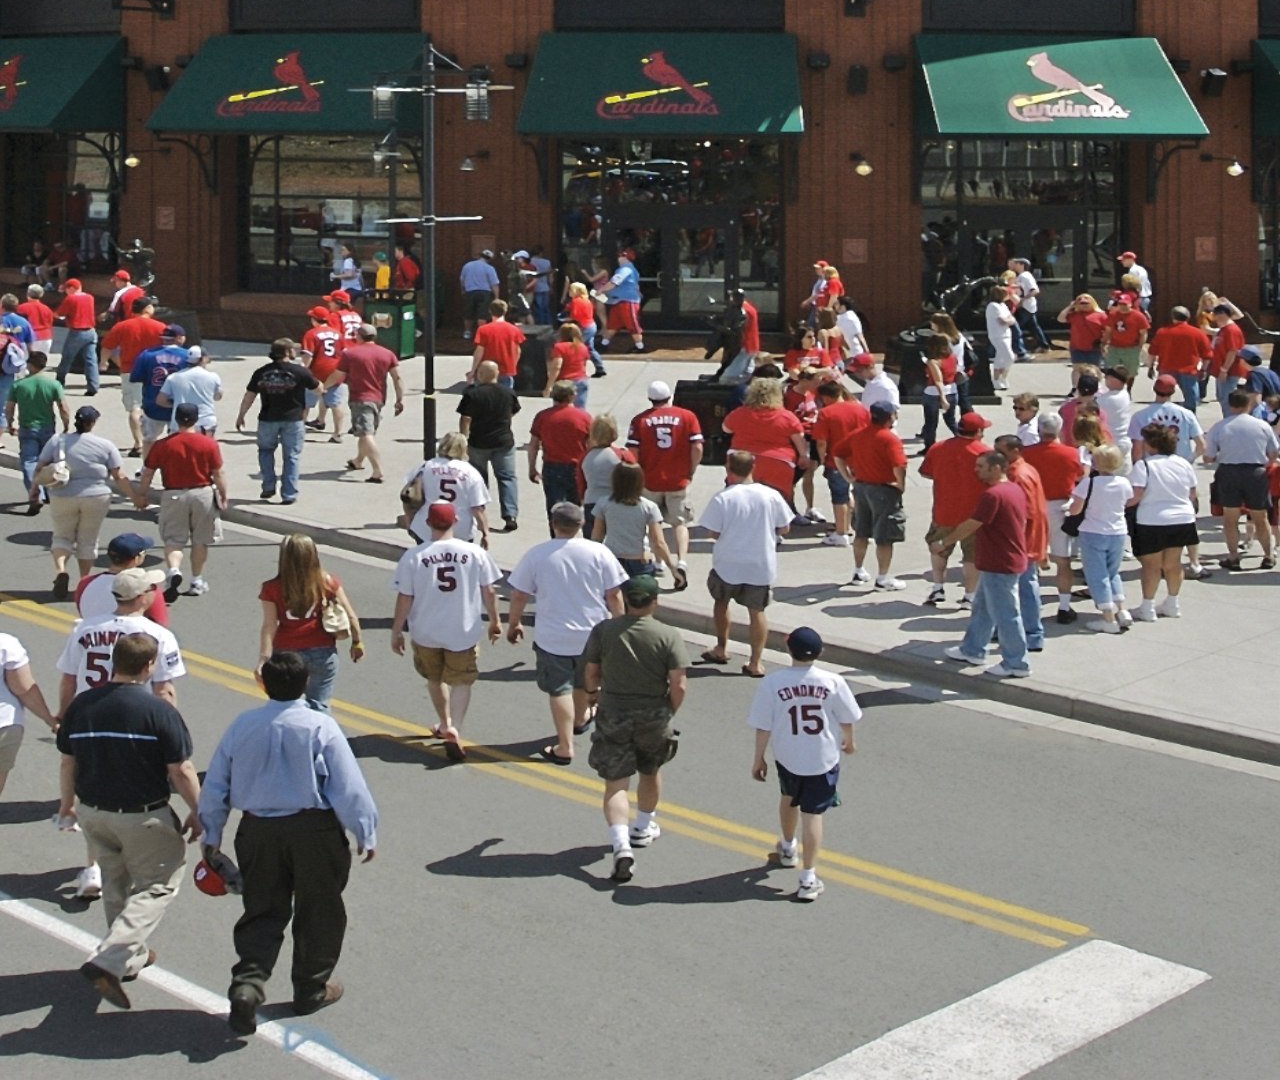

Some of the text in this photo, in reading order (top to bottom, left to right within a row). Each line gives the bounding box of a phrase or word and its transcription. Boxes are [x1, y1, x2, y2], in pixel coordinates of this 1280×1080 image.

[596, 94, 719, 119] Cardinals
[1008, 95, 1131, 122] Cardinals
[324, 339, 336, 356] 5
[645, 415, 680, 427] PUJOLS
[656, 426, 672, 449] 5
[438, 478, 457, 503] 5
[421, 551, 469, 568] PUJOLS
[436, 565, 458, 593] 5
[777, 684, 831, 701] EDMONDS
[788, 704, 824, 736] 15
